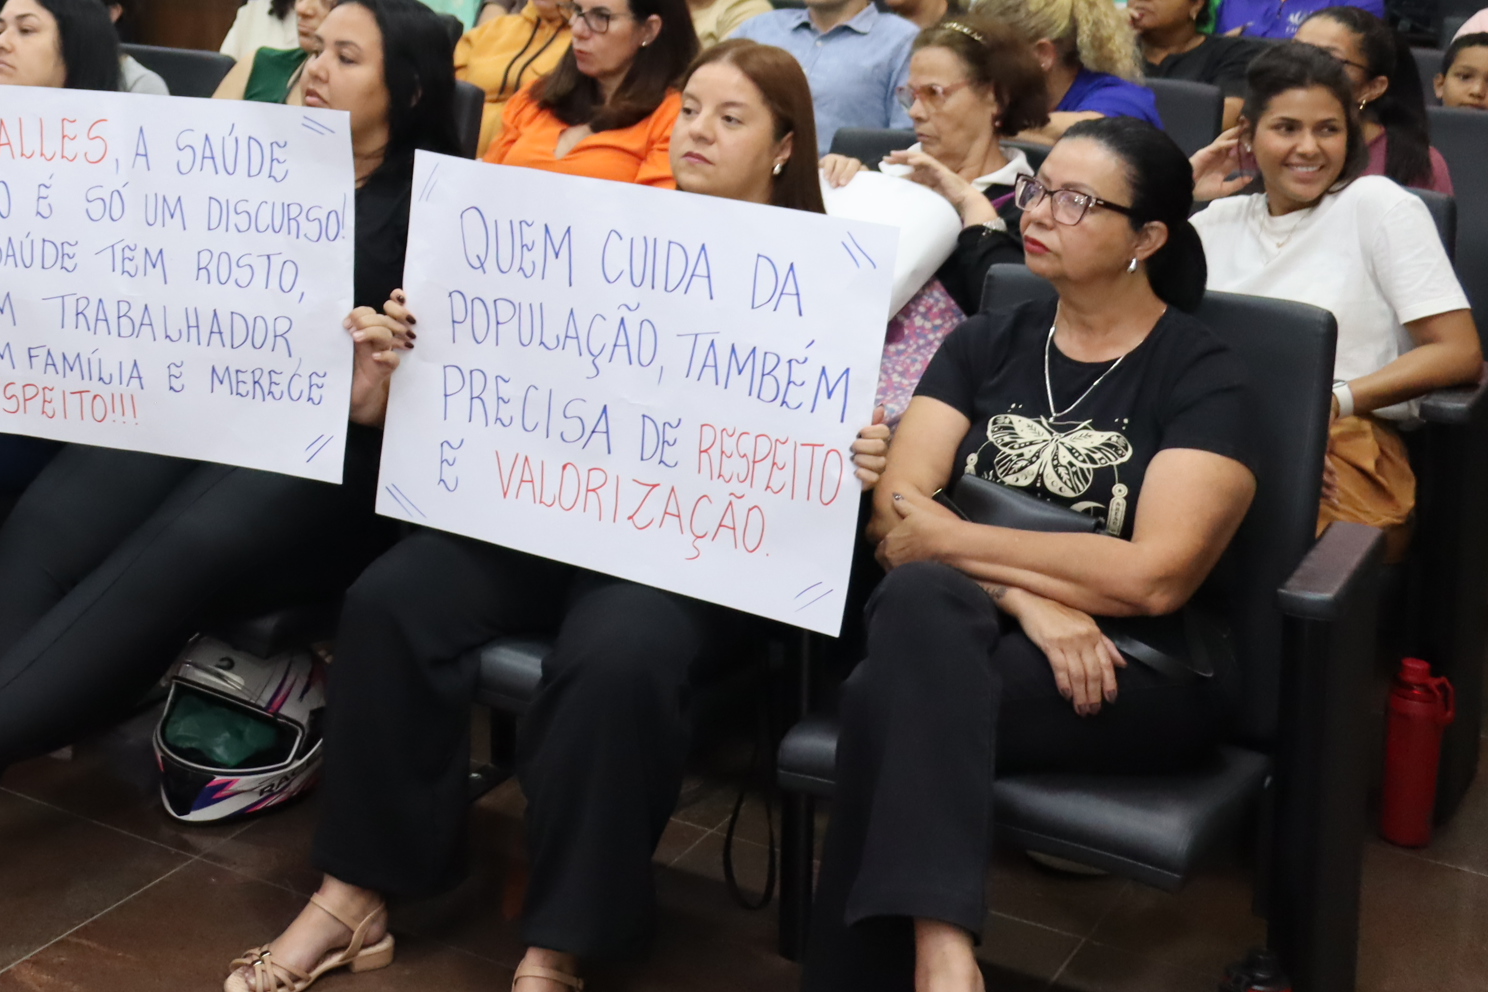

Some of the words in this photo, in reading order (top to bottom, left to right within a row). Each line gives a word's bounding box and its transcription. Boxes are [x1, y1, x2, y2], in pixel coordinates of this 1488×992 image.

[131, 125, 151, 172] A
[175, 122, 290, 184] SAÚDE
[35, 173, 54, 220] É
[85, 181, 130, 222] SÓ
[144, 192, 187, 232] UM
[207, 192, 347, 244] DISCURSO!
[94, 238, 168, 286] TEM
[195, 247, 306, 305] ROSTO,
[459, 205, 573, 288] QUEM
[601, 228, 714, 301] CUIDA
[750, 252, 804, 318] DA
[28, 348, 145, 391] FAMÍLIA
[167, 360, 185, 394] E
[447, 289, 665, 386] POPULAÇÃO,
[676, 330, 852, 423] TAMBÉM
[442, 364, 613, 456] PRECISA
[640, 412, 683, 468] DE
[697, 422, 844, 506] RESPEITO
[437, 438, 465, 493] E
[494, 449, 770, 561] VALORIZAÇÃO.
